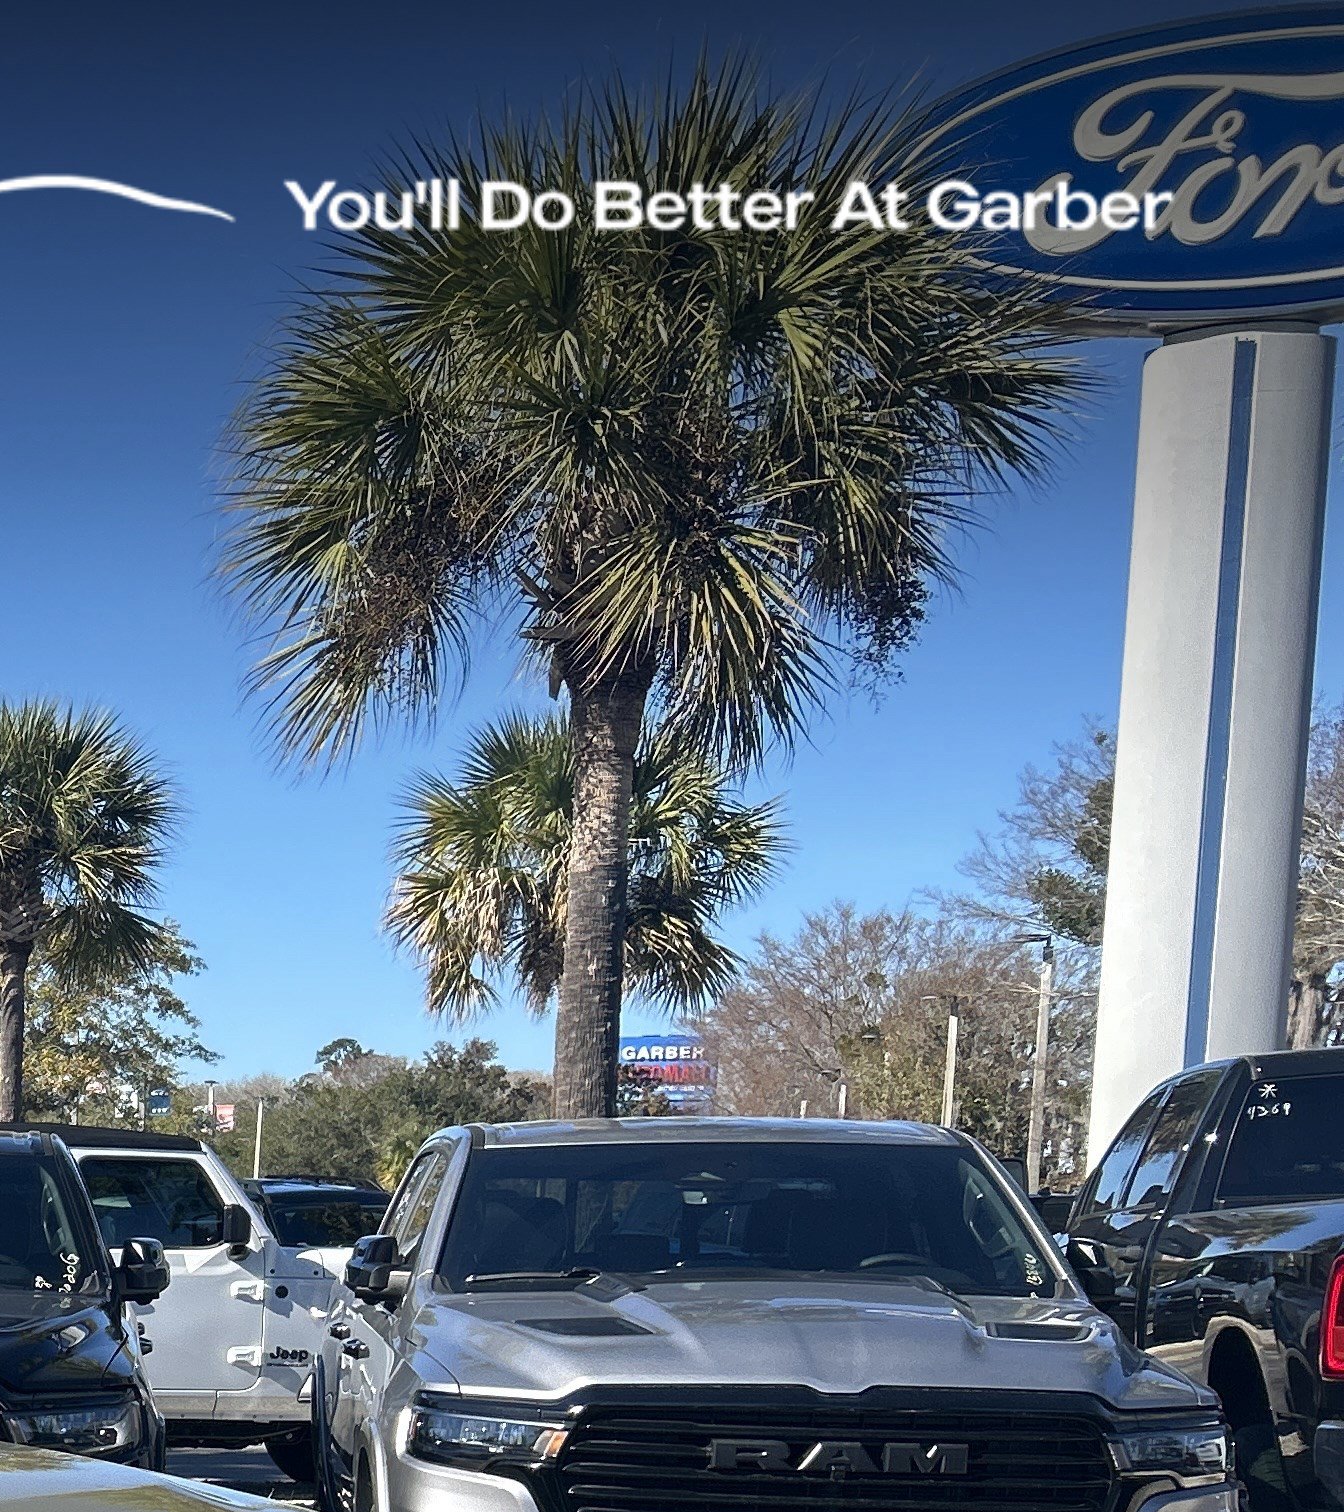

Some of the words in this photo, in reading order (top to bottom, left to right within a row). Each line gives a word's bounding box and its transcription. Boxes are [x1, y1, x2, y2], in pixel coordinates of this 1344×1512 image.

[1023, 74, 1344, 256] For
[621, 1045, 705, 1061] GARBER
[269, 1345, 309, 1363] Jeep
[710, 1438, 969, 1475] RAM
